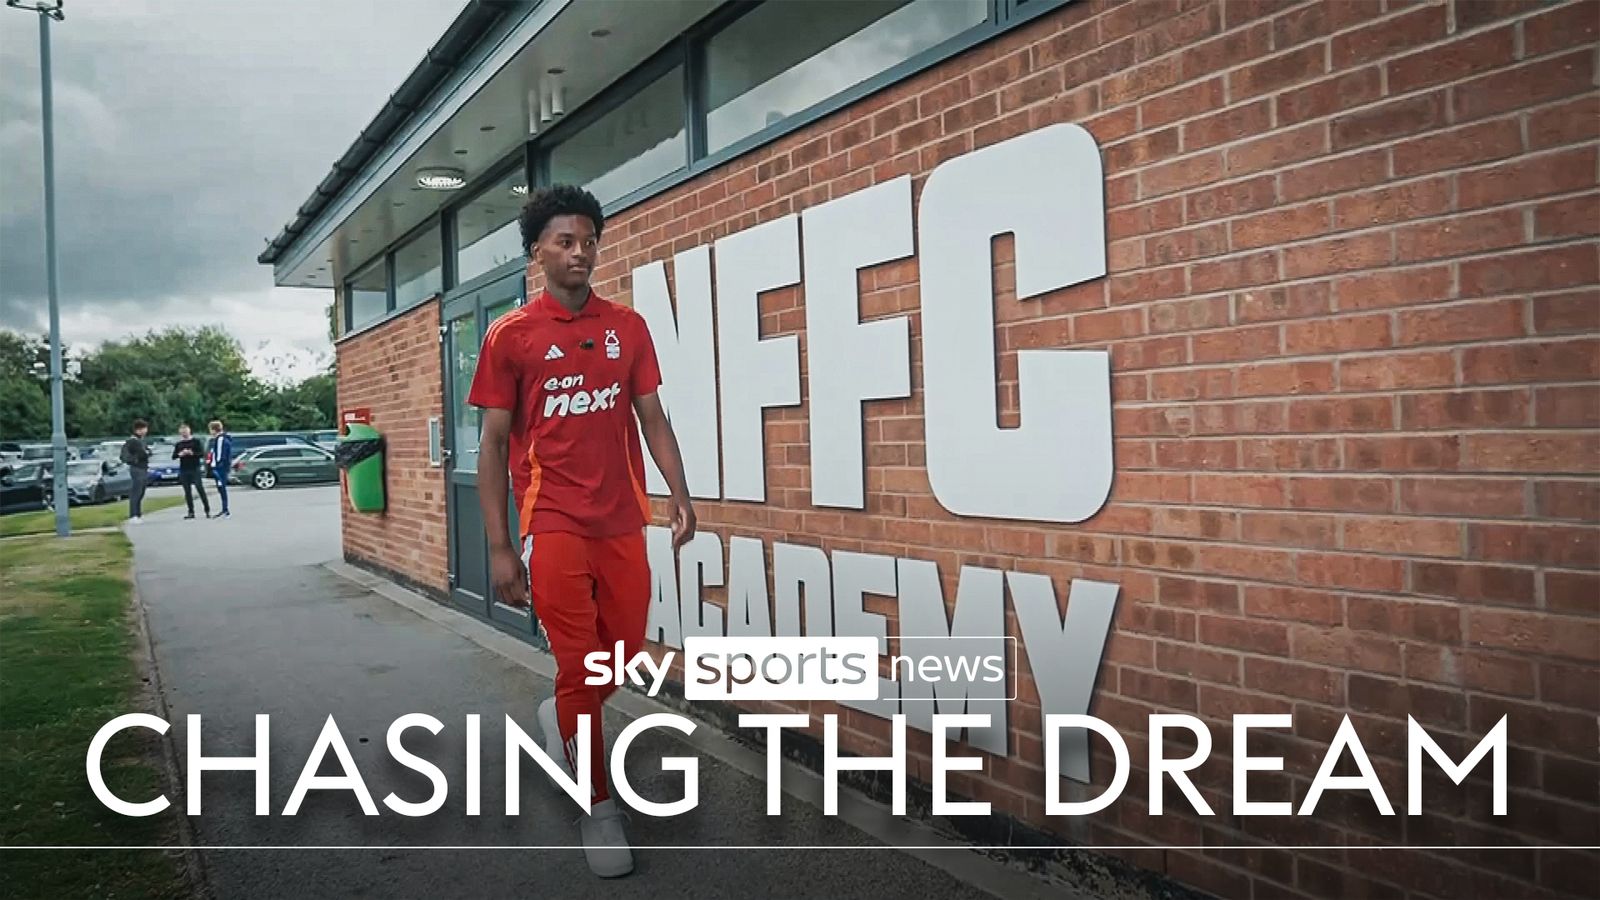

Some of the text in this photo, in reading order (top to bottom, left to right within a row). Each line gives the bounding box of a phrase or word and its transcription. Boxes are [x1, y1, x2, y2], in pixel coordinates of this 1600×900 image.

[543, 382, 621, 418] next
[633, 122, 1114, 523] NFFC
[646, 526, 1120, 784] ACADEMY
